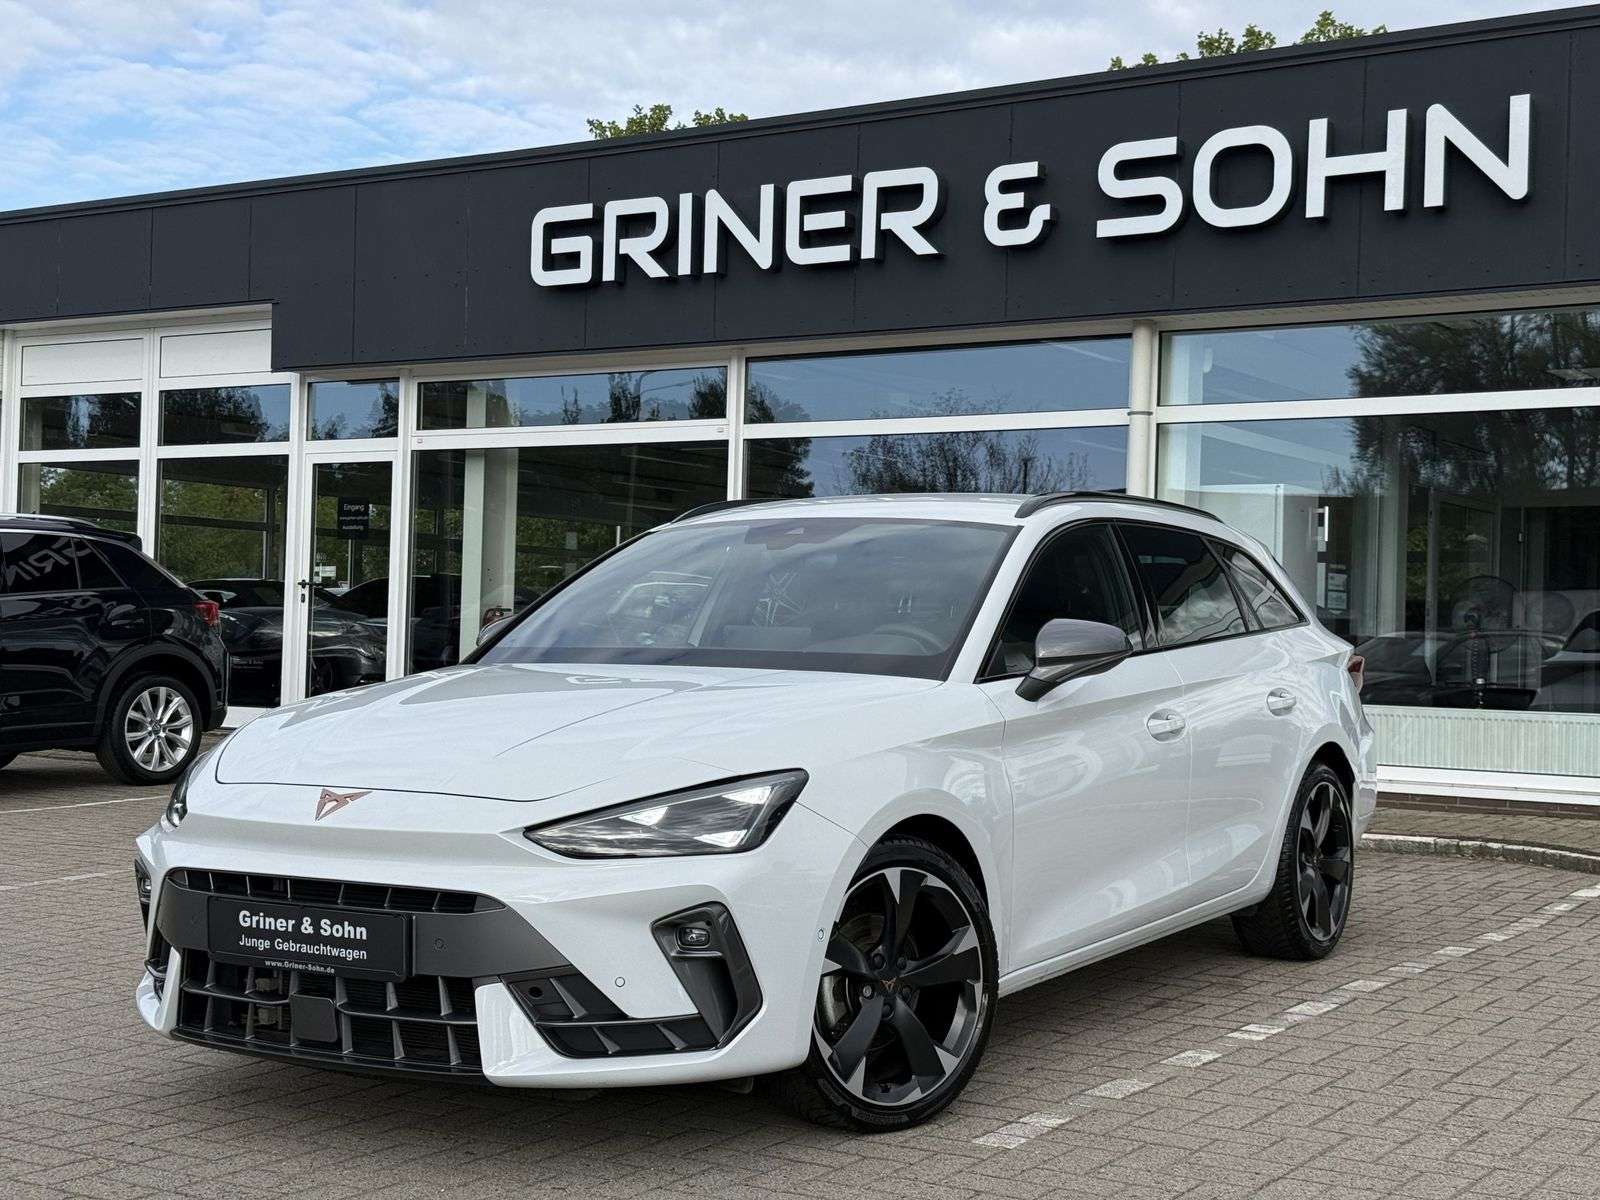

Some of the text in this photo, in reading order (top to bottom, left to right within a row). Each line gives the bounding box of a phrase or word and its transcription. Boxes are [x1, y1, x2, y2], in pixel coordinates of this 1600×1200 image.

[530, 93, 1532, 287] GRINER & SOHN
[238, 910, 368, 941] Griner & Sohn
[239, 934, 368, 961] Junge Gebrauchtwagen
[265, 960, 335, 974] www.Griner-Sohn.de
